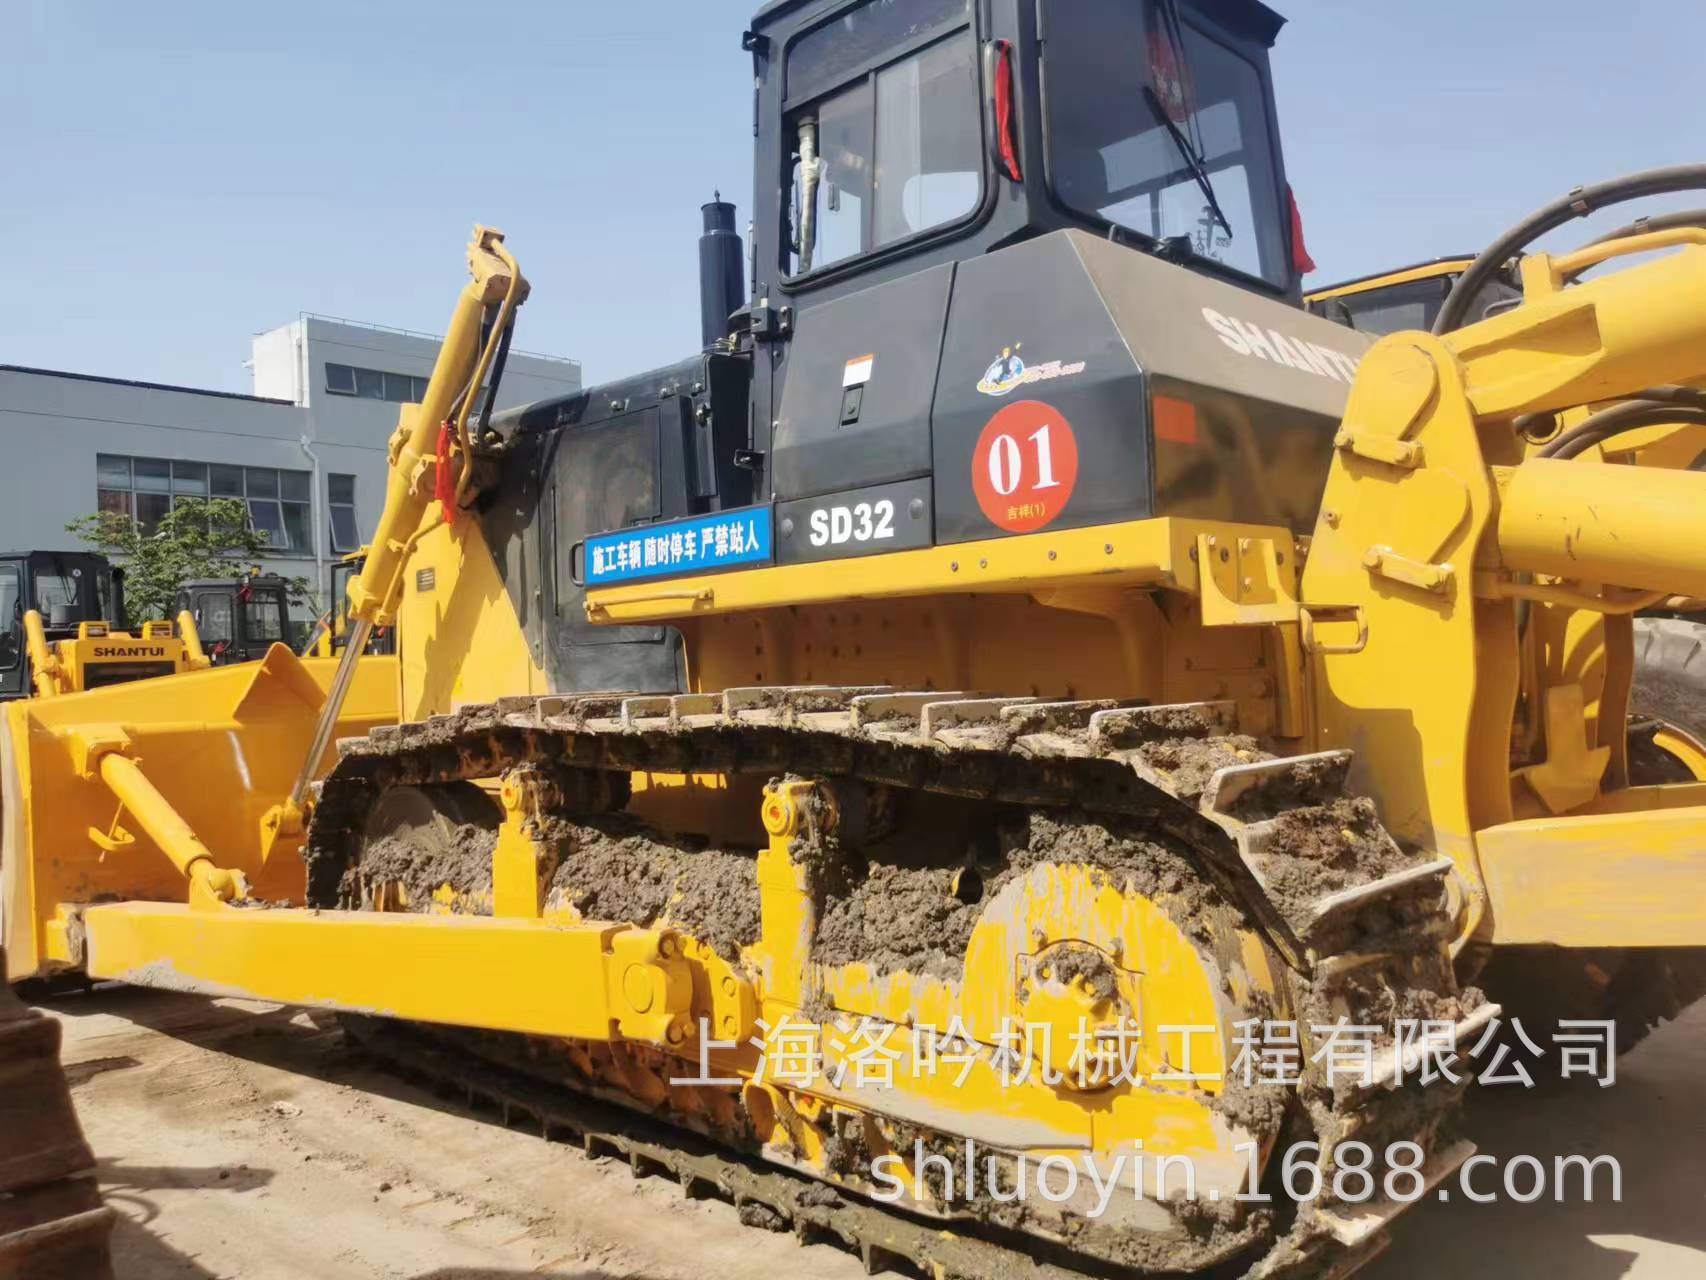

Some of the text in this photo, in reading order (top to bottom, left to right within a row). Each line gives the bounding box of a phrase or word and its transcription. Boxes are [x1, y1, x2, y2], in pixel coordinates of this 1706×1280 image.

[988, 423, 1061, 496] 01
[592, 519, 760, 576] 施工车辆 随时停车 严禁站人
[809, 499, 895, 547] SD32
[93, 646, 165, 657] SHANTUI
